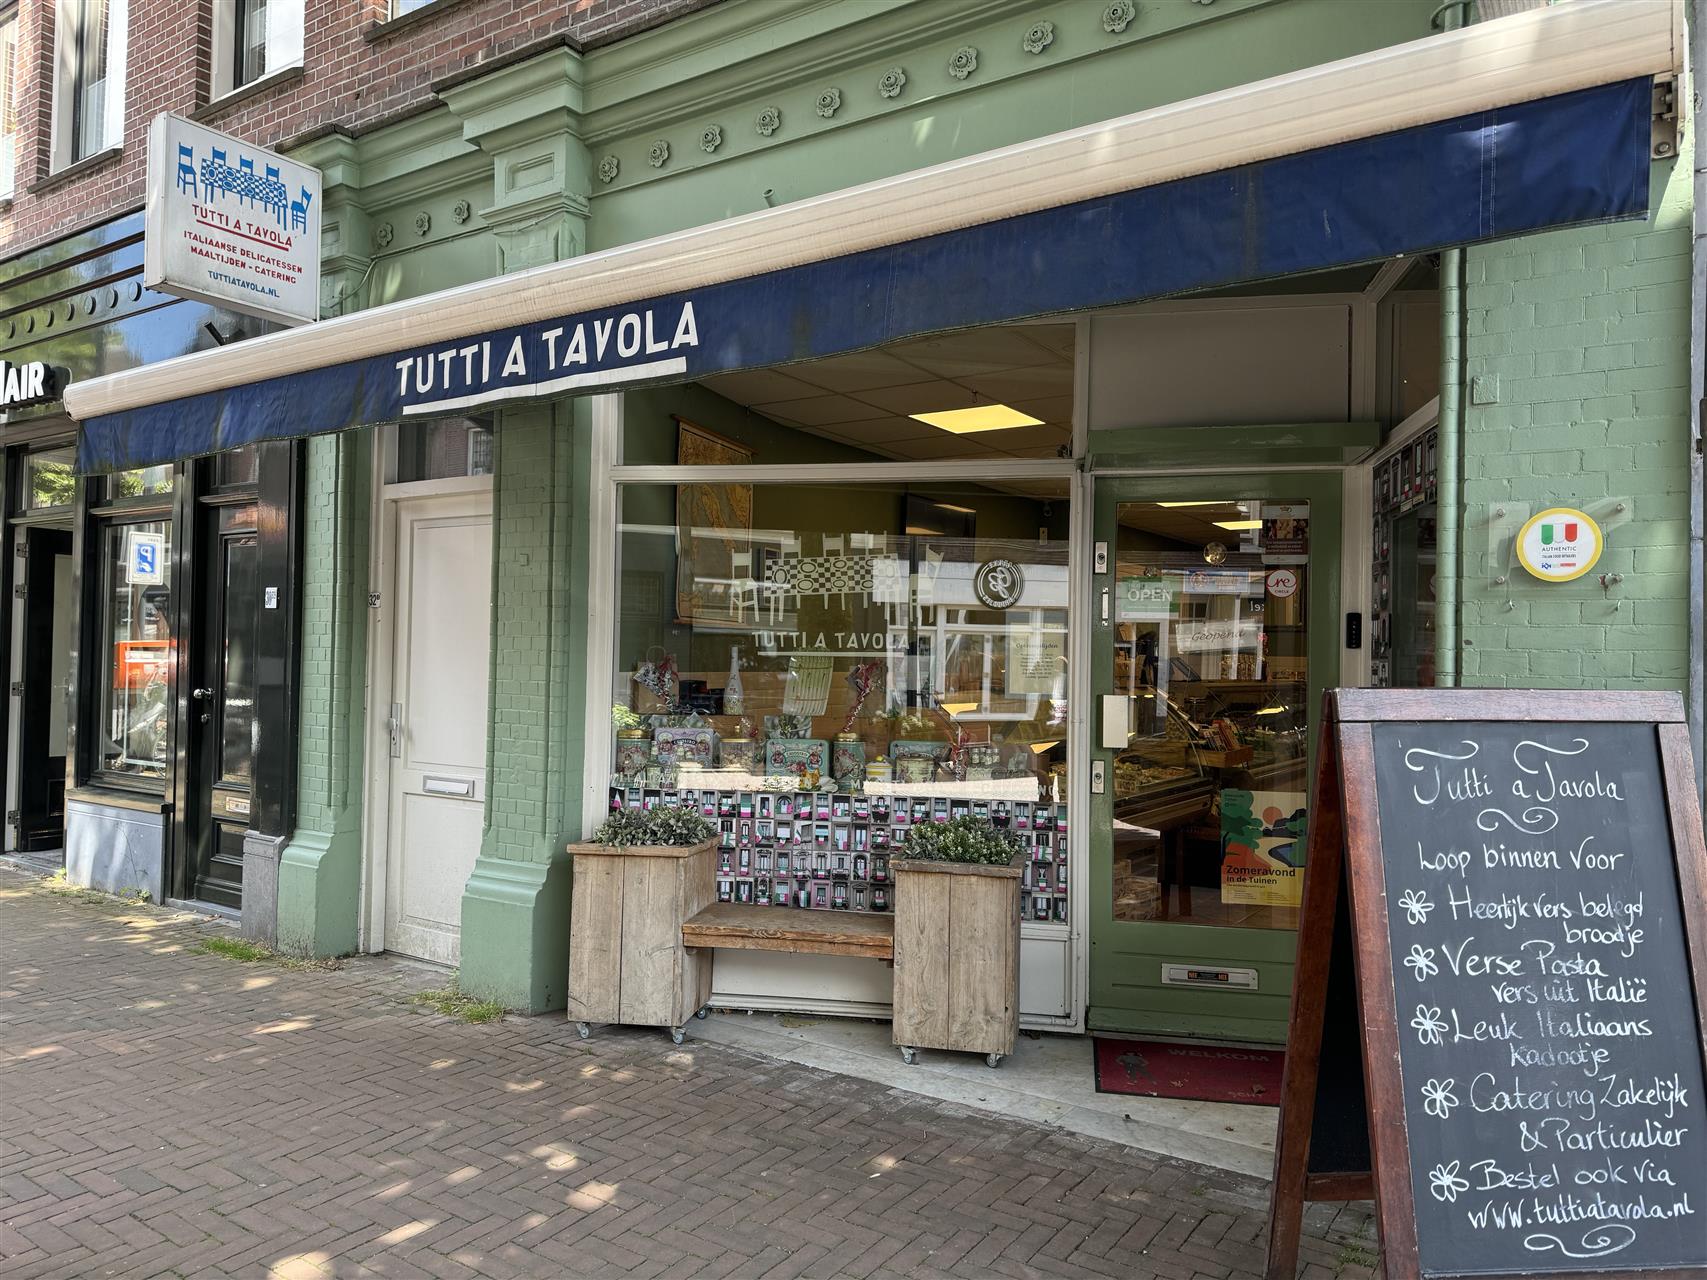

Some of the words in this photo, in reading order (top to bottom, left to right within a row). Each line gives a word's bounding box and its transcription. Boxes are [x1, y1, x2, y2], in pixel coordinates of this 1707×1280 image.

[192, 204, 229, 226] TUTTI
[233, 219, 242, 231] A
[246, 223, 293, 247] TAVOLA
[184, 230, 237, 254] ITALIAANSE
[240, 248, 302, 274] DELICATESSEN
[191, 246, 246, 269] MAALTIJDEN
[255, 266, 297, 284] CATERING
[208, 270, 280, 298] TUTTIATAVOLA.NL
[396, 341, 491, 396] TUTTI
[501, 335, 526, 377] A
[542, 301, 699, 370] TAVOLA
[1127, 589, 1173, 602] OPEN
[752, 631, 806, 648] TUTTI
[814, 631, 827, 649] A
[834, 632, 910, 649] TAVOLA
[1405, 740, 1493, 804] Tutti
[1514, 738, 1624, 802] Tavola
[1512, 781, 1530, 799] a
[1226, 865, 1296, 877] Zomeravond
[1418, 841, 1471, 878] Loop
[1484, 843, 1561, 869] binnen
[1448, 884, 1531, 930] Heerlijk
[1442, 937, 1526, 976] Verse
[1521, 940, 1609, 977] Pasta
[1563, 921, 1644, 957] broodje
[1587, 977, 1648, 1003] Italië
[1452, 1008, 1523, 1043] Leuk
[1536, 1011, 1653, 1038] Italiaans
[1167, 1049, 1270, 1062] WELKOM
[1470, 1073, 1595, 1120] Catering
[1600, 1073, 1688, 1118] Zakelijk
[1519, 1121, 1548, 1151] &
[1541, 1117, 1688, 1152] Particulier
[1469, 1159, 1560, 1190] Bestel
[1575, 1157, 1627, 1185] ook
